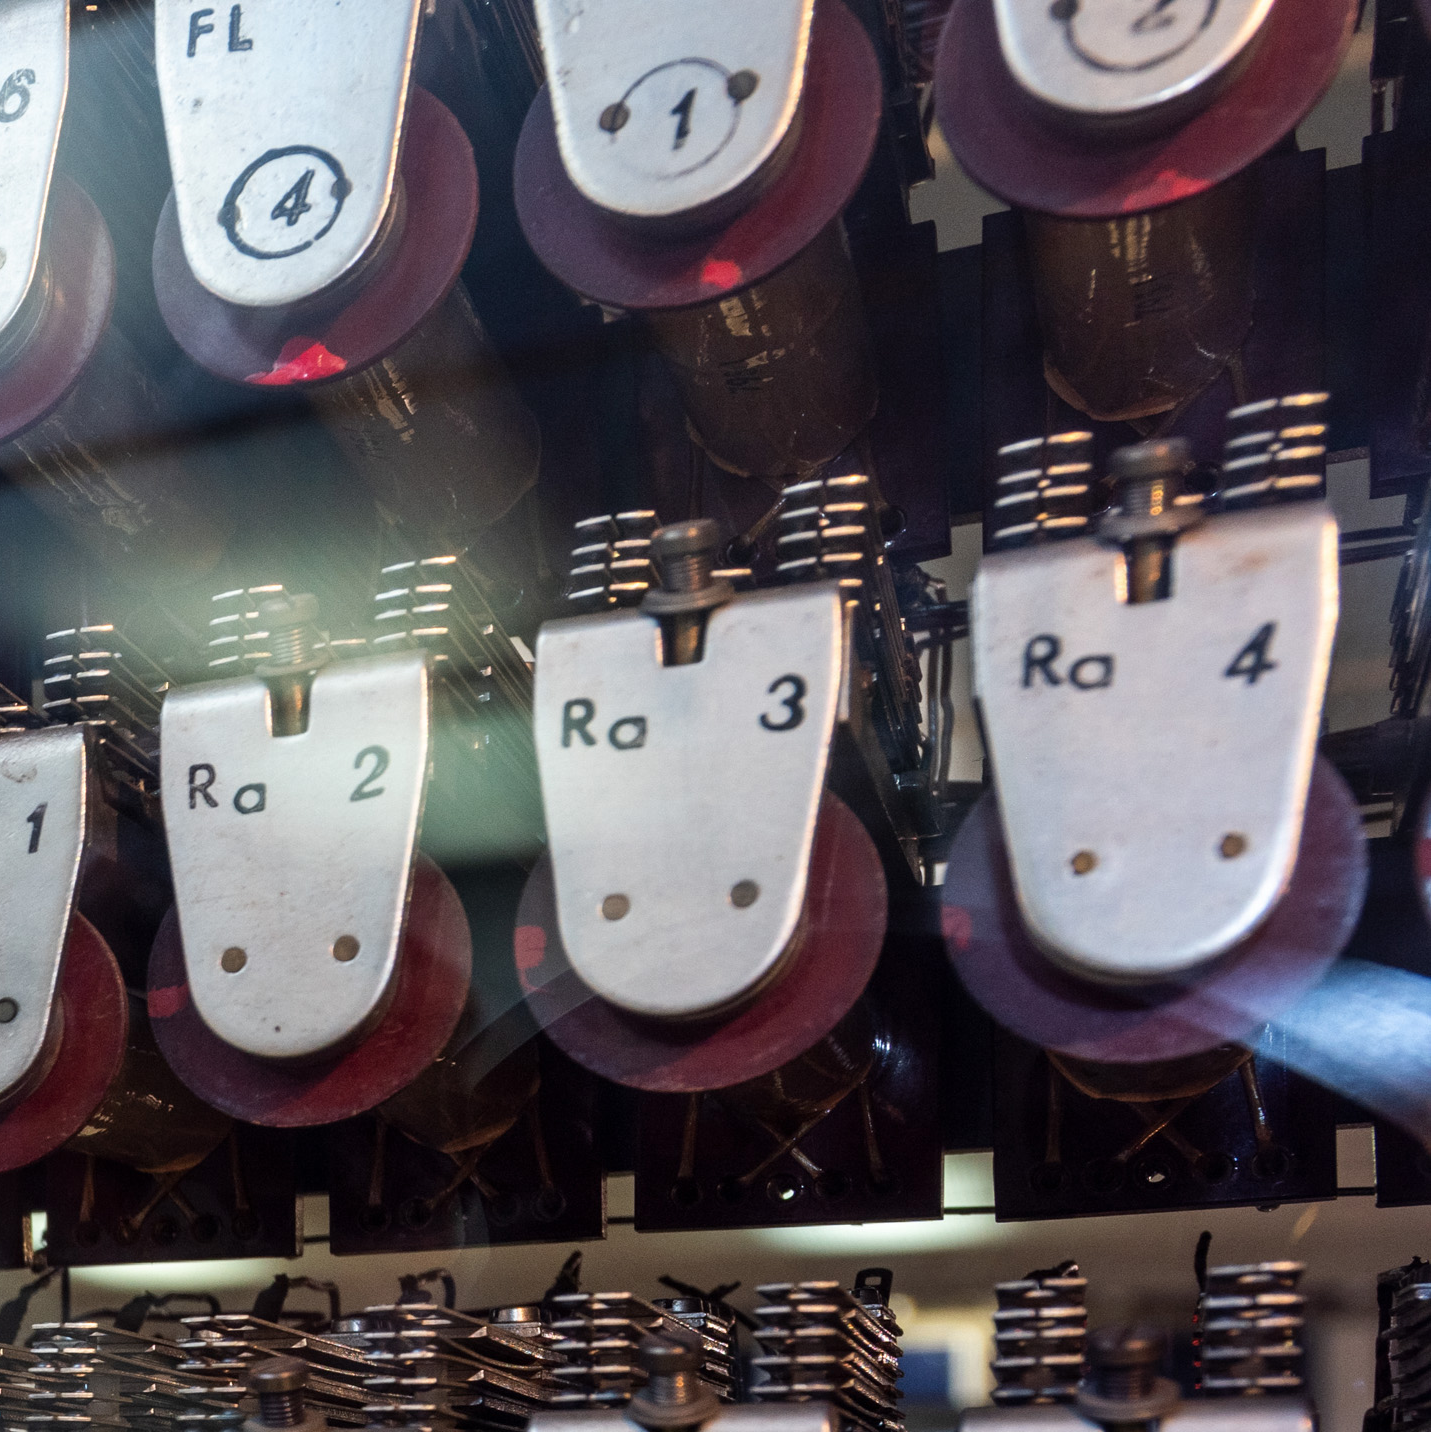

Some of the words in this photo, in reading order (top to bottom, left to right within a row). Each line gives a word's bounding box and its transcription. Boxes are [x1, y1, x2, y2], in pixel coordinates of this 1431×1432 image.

[186, 3, 254, 58] FL
[669, 87, 698, 151] 1
[270, 168, 316, 227] 4
[1022, 633, 1116, 689] Ra
[1223, 621, 1278, 685] 4
[560, 698, 647, 750] Ra
[758, 673, 807, 732] 3
[188, 763, 269, 815] Ra
[349, 744, 392, 802] 2
[26, 802, 47, 855] 1
